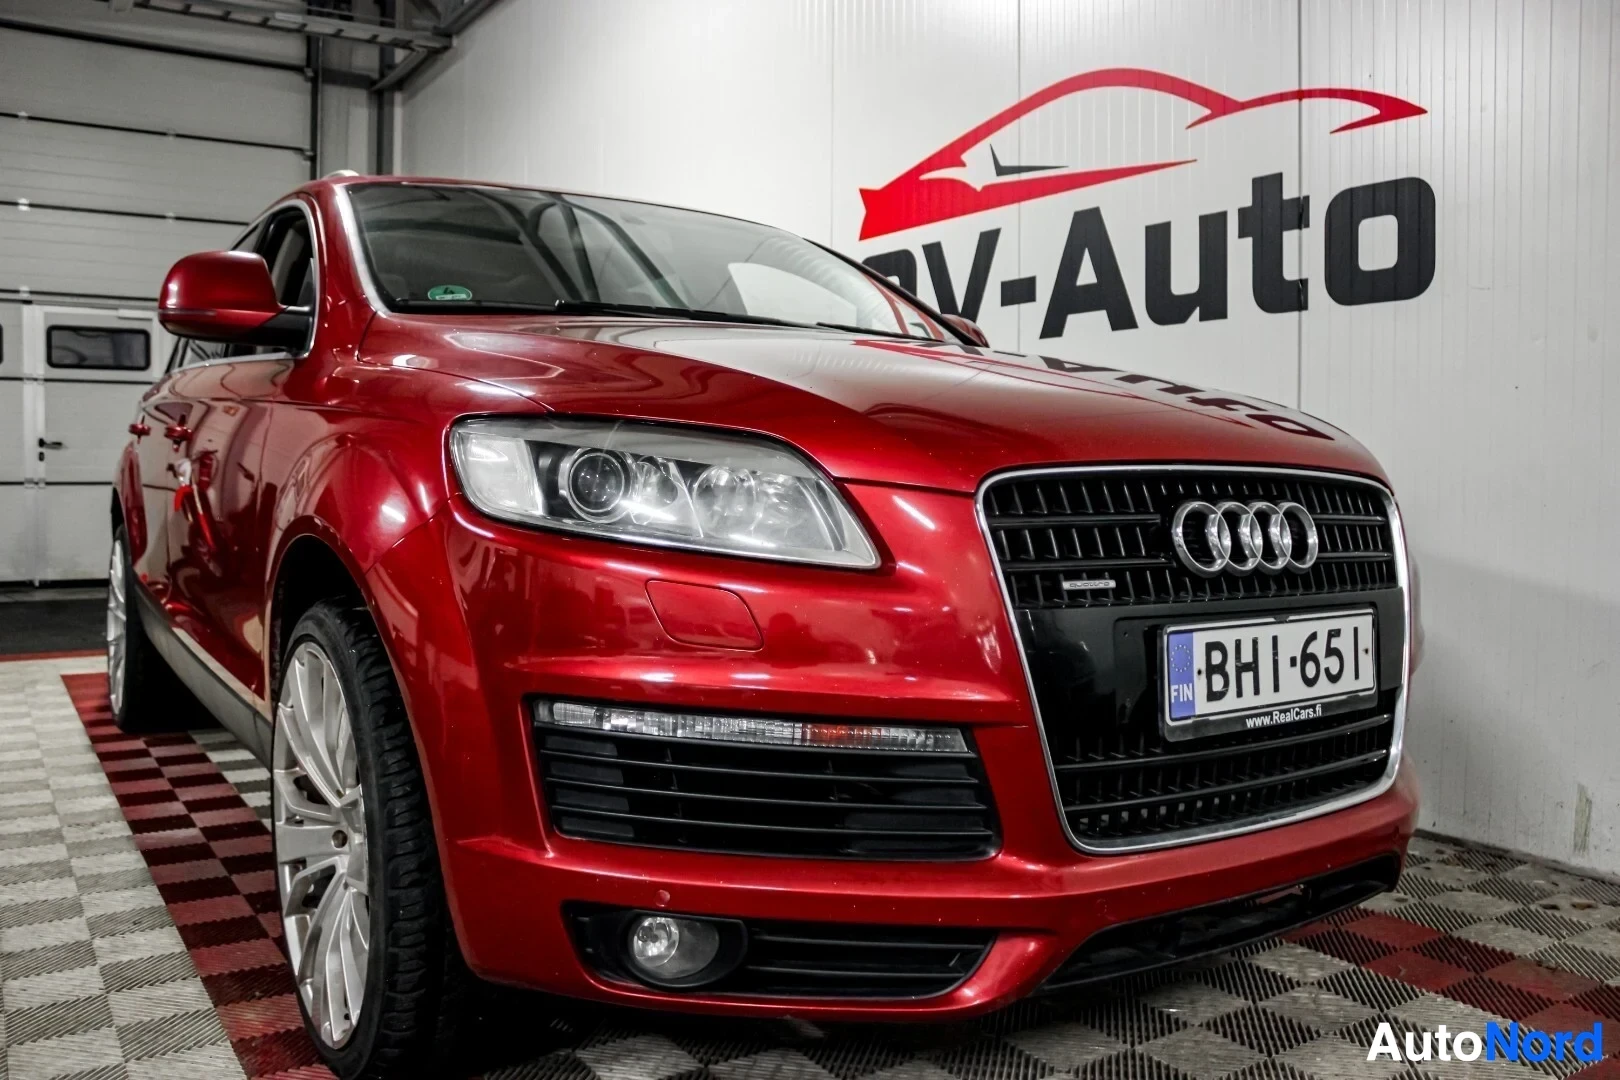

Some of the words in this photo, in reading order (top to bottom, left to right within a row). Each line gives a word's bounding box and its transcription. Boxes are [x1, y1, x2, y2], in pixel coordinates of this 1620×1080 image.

[1204, 626, 1360, 703] BHI-651
[1170, 683, 1194, 704] FIN
[1245, 704, 1322, 728] www.RealCars.fi
